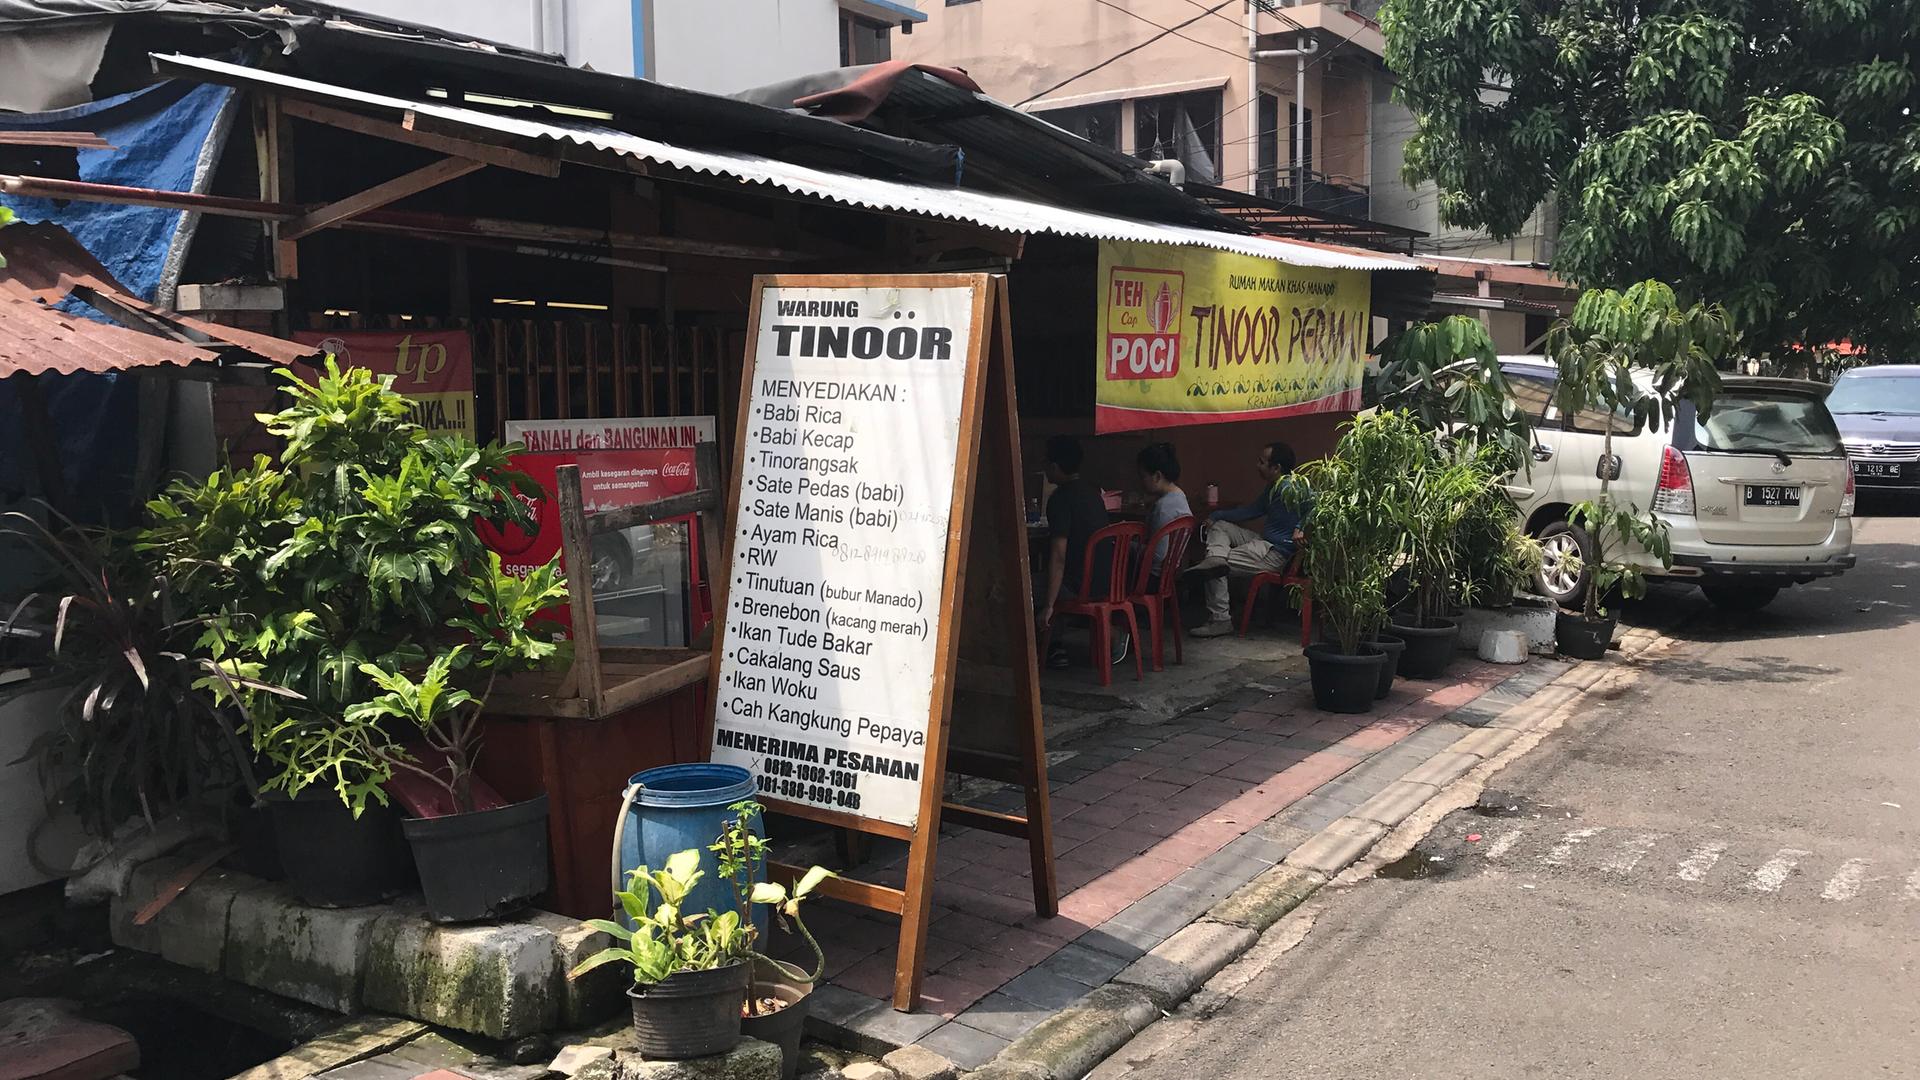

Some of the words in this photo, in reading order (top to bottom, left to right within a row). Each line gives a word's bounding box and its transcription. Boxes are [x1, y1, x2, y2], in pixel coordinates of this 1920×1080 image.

[1114, 280, 1143, 307] TEH
[1229, 274, 1257, 290] RUMAH
[1258, 277, 1285, 292] MAKAN
[1286, 280, 1306, 294] KHAS
[777, 300, 859, 318] WARUNG
[1121, 312, 1138, 327] Cap
[1190, 304, 1280, 370] TINOOR
[395, 335, 447, 384] tp
[1110, 337, 1175, 375] POCI
[761, 380, 896, 402] MENYEDIAKAN
[763, 404, 799, 422] Babi
[805, 405, 842, 424] Rica
[522, 429, 572, 451] TANAH
[576, 429, 600, 449] dan
[604, 426, 677, 449] BANGUNAN
[760, 427, 796, 445] Babi
[802, 428, 854, 451] Kecap
[582, 470, 600, 479] Ambil
[601, 468, 630, 479] kesegaran
[759, 451, 858, 476] Tinorangsak
[593, 482, 611, 491] untuk
[611, 480, 649, 490] semangatmu
[756, 475, 792, 495] Sate
[798, 478, 849, 498] Pedas
[855, 481, 904, 506] (babi)
[1746, 486, 1752, 499] B
[1761, 487, 1780, 500] 1527
[1784, 487, 1800, 500] PKU
[753, 499, 790, 519] Sate
[794, 502, 843, 523] Manis
[849, 507, 898, 532] (babi)
[751, 524, 796, 546] Ayam
[802, 528, 839, 549] Rica
[747, 548, 778, 567] RW
[746, 572, 815, 596] Tinutuan
[820, 580, 862, 605] (bubur
[865, 589, 923, 613] Manado)
[742, 597, 820, 623] Brenebon
[825, 607, 876, 633] (kacang
[880, 618, 928, 641] merah)
[739, 621, 771, 642] Ikan
[777, 626, 817, 648] Tude
[823, 632, 873, 656] Bakar
[737, 647, 812, 677] Cakalang
[818, 658, 861, 681] Saus
[733, 671, 766, 692] Ikan
[771, 676, 817, 700] Woku
[731, 697, 762, 718] Cah
[768, 702, 851, 737] Kangkung
[857, 718, 924, 746] Pepaya
[716, 729, 819, 763] MENERIMA
[823, 747, 919, 781] PESANAN
